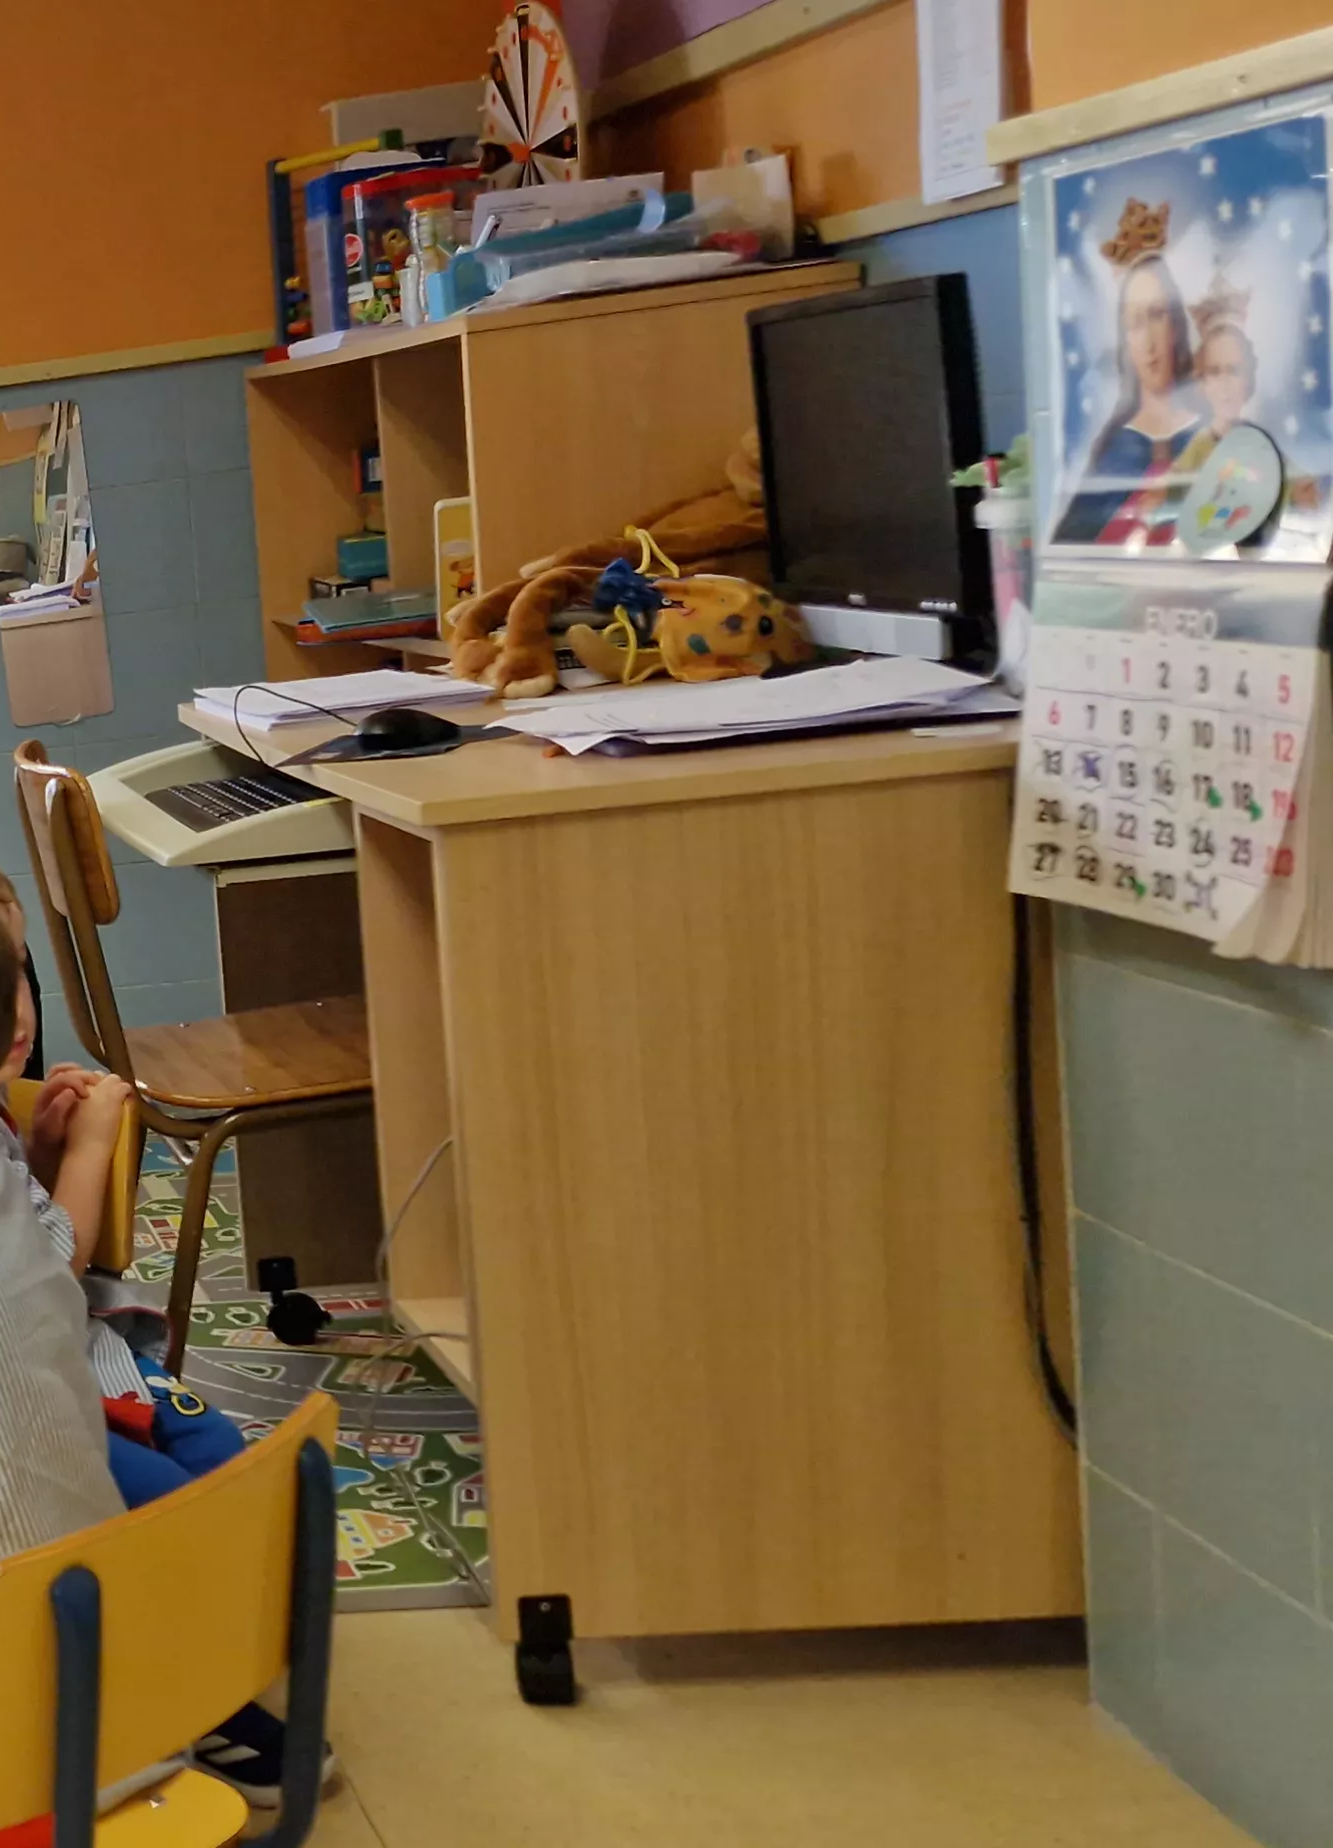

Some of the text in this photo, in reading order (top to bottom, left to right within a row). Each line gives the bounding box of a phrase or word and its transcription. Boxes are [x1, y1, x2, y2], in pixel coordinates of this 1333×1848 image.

[1121, 656, 1291, 705] 1 2 3 4 5
[1047, 700, 1296, 763] 6 7 8 9 10 11 12
[1117, 759, 1140, 788] 15
[1152, 765, 1176, 796] 16
[1192, 773, 1214, 804] 17
[1078, 802, 1100, 833] 21
[1115, 811, 1139, 841] 22
[1153, 819, 1178, 849] 23
[1190, 826, 1216, 857] 24
[1230, 835, 1253, 867] 25
[1152, 870, 1178, 901] 30
